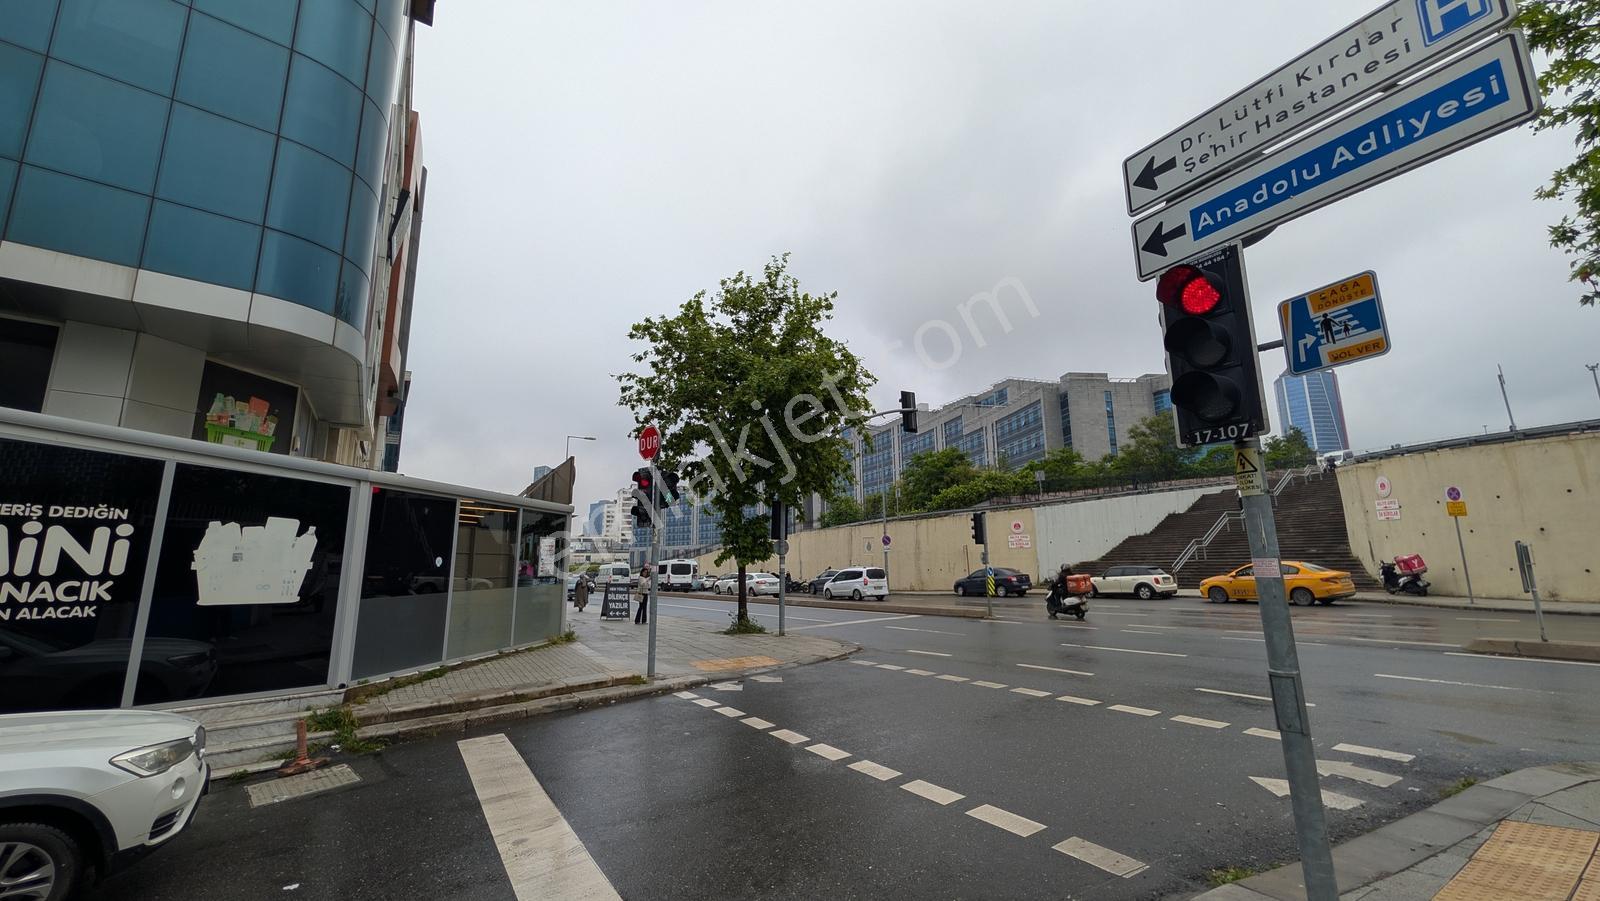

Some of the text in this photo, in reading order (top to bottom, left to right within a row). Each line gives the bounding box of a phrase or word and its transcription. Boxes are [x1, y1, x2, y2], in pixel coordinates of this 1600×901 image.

[1180, 17, 1403, 153] Dr. Lütfi Kırdar
[1183, 38, 1410, 173] Şehir Hastanesi
[1197, 74, 1500, 232] Anadolu Adliyesi
[1356, 342, 1381, 355] VER
[640, 435, 658, 451] DUR
[1194, 423, 1250, 444] 17-107
[15, 605, 97, 620] ALACAK
